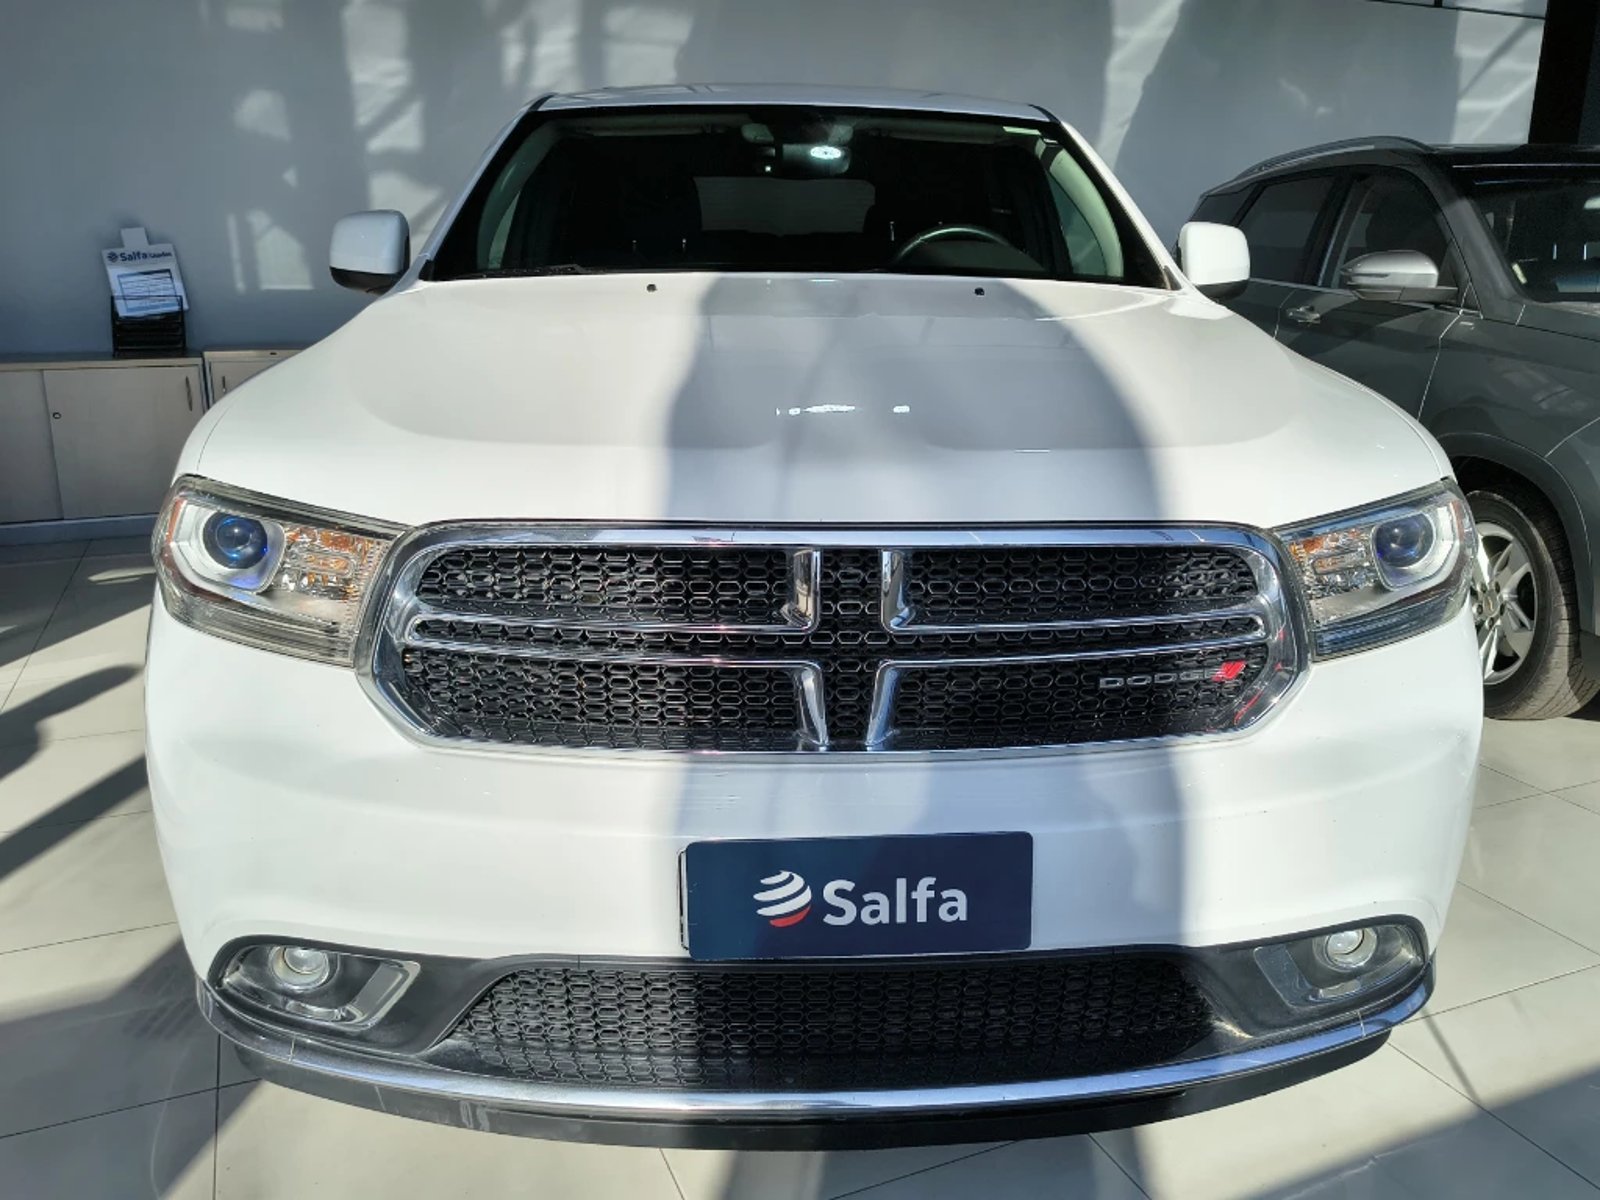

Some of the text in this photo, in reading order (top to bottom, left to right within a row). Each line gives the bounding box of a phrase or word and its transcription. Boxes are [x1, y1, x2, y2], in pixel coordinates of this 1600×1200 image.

[120, 251, 147, 262] Salfa
[1100, 668, 1222, 689] DODGE
[822, 876, 968, 926] Salfa
